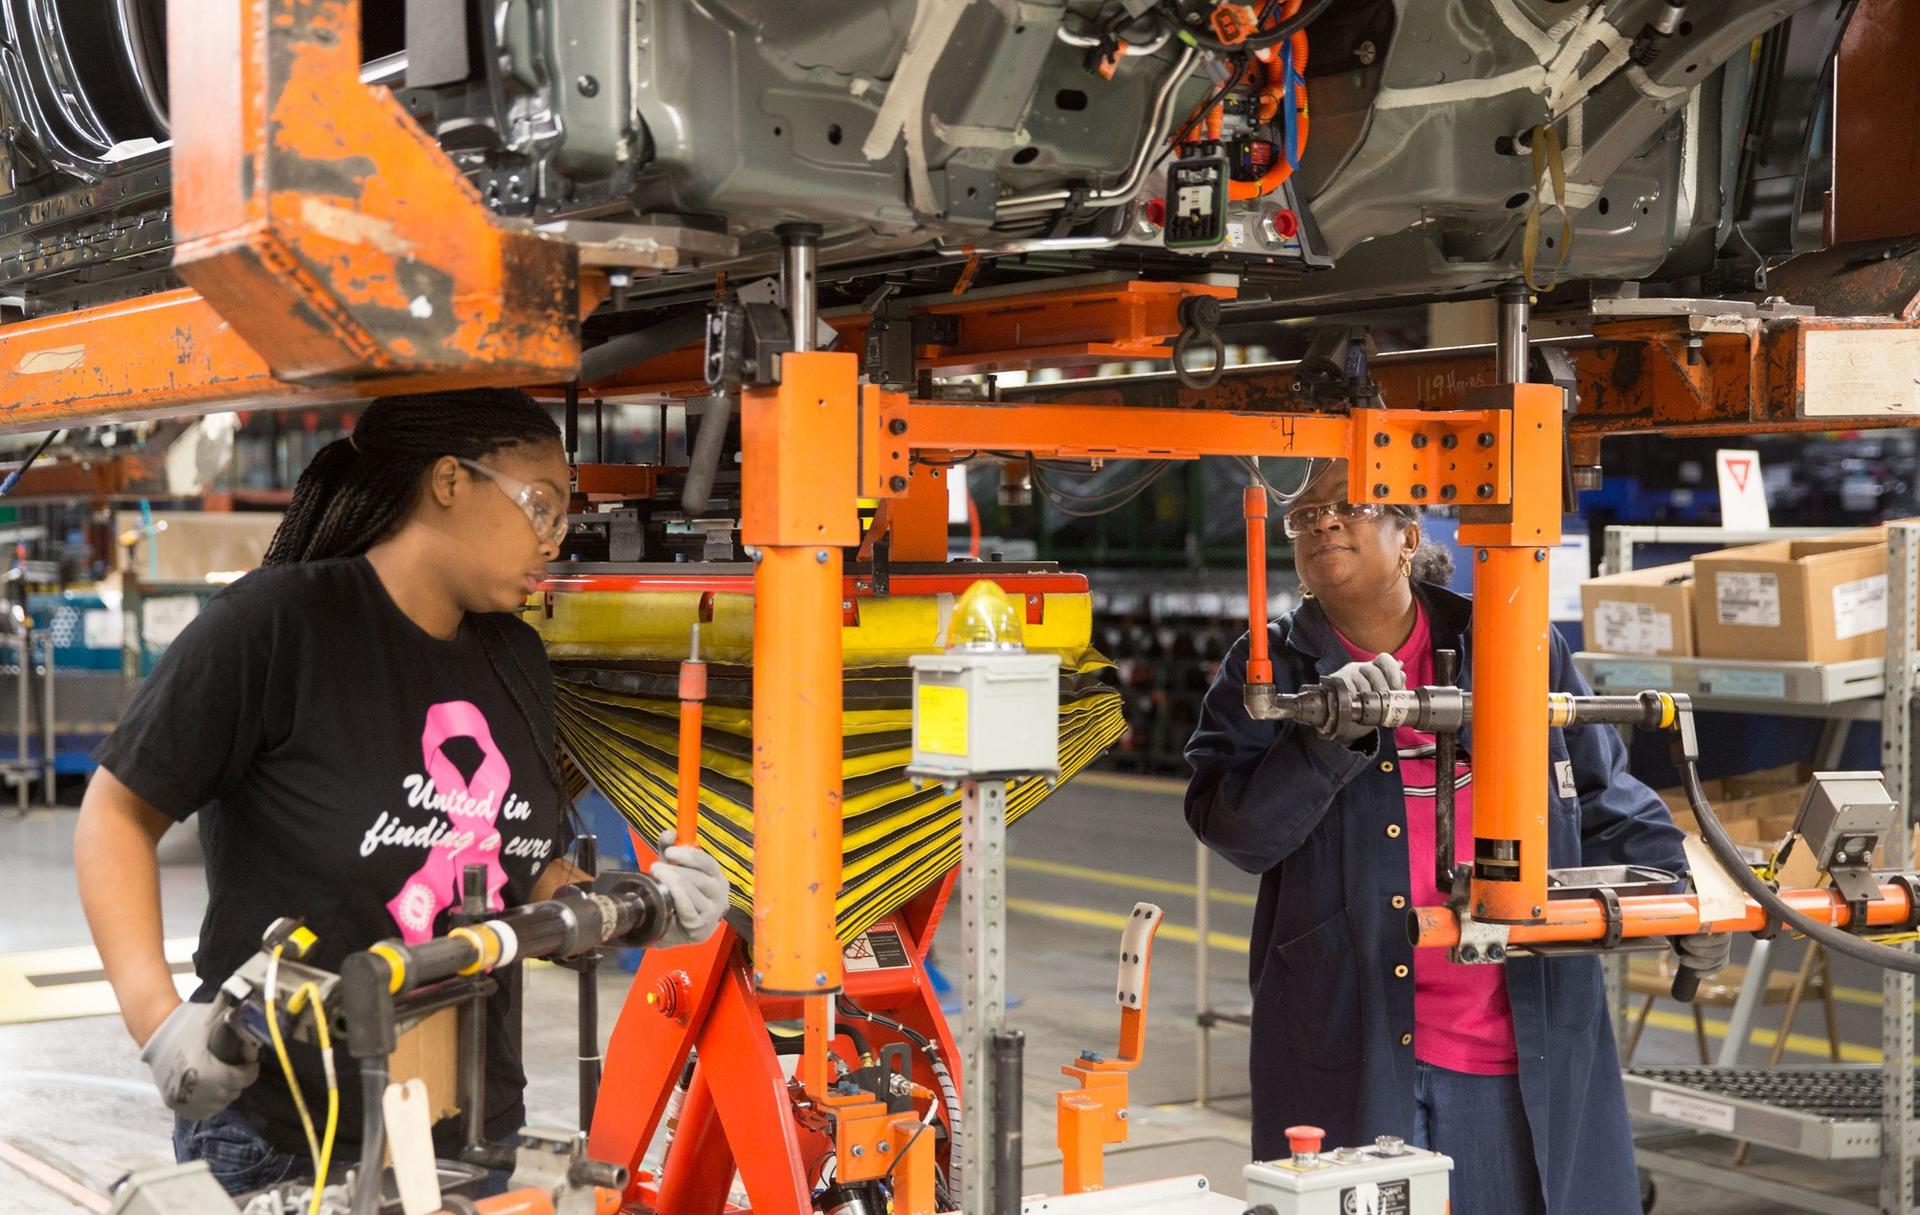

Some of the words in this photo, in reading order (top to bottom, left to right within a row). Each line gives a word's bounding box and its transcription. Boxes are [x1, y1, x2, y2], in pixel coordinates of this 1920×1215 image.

[403, 773, 496, 819] United
[503, 793, 532, 820] in
[360, 811, 475, 860] finding
[479, 833, 501, 852] a
[504, 836, 552, 859] cure
